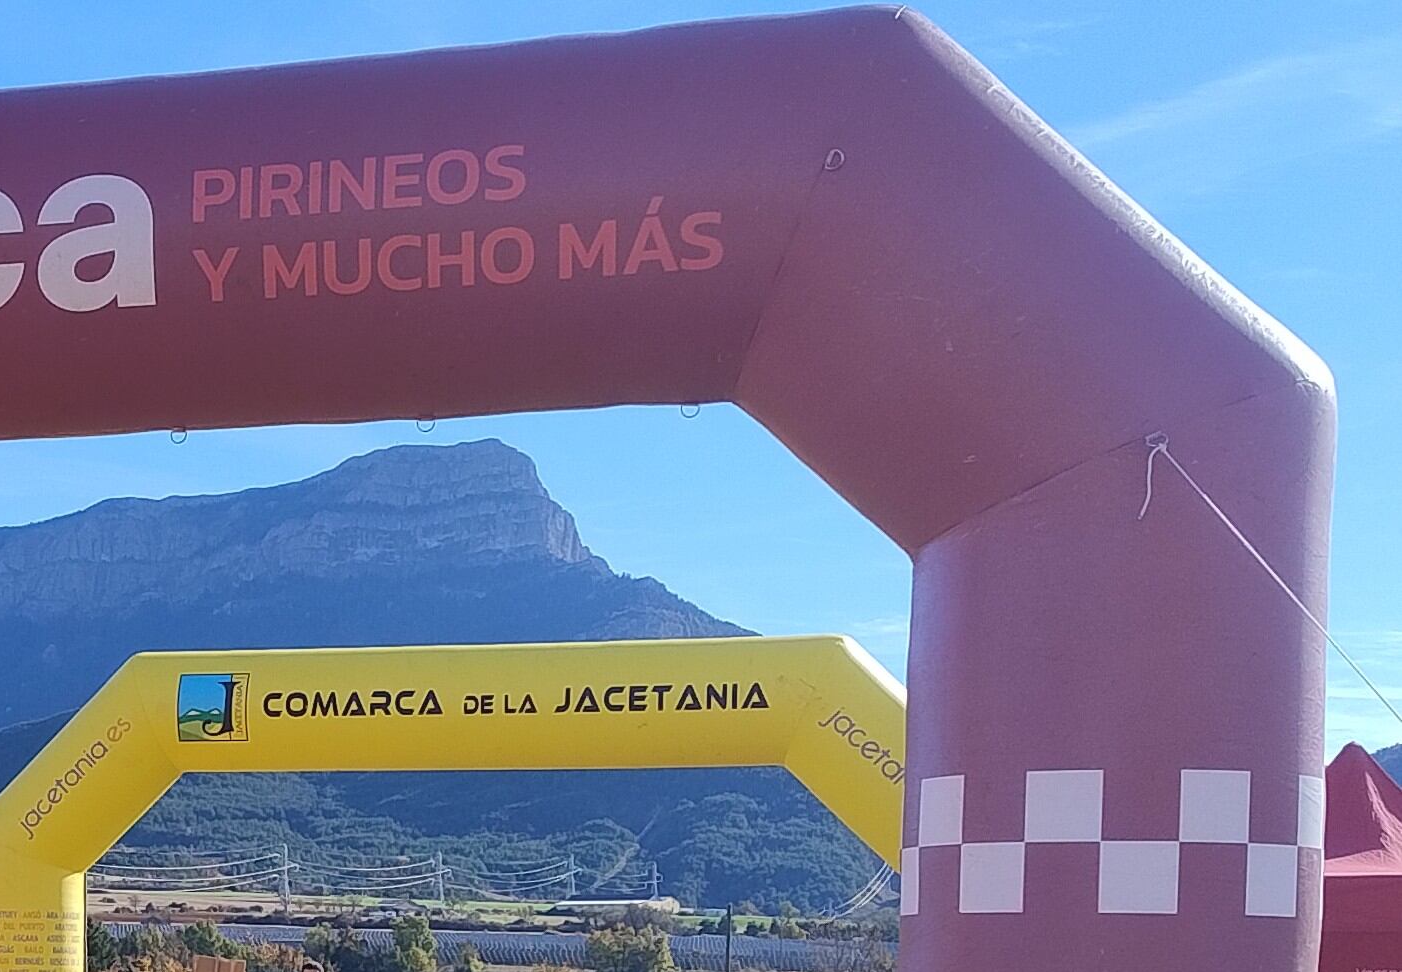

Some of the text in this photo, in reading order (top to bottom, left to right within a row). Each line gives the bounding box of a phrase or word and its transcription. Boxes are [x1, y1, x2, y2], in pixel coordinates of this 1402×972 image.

[192, 145, 527, 223] PIRINEOS
[192, 196, 725, 302] Y MUCHO MÁS
[263, 682, 770, 718] COMARCA DE LA JACETANIA
